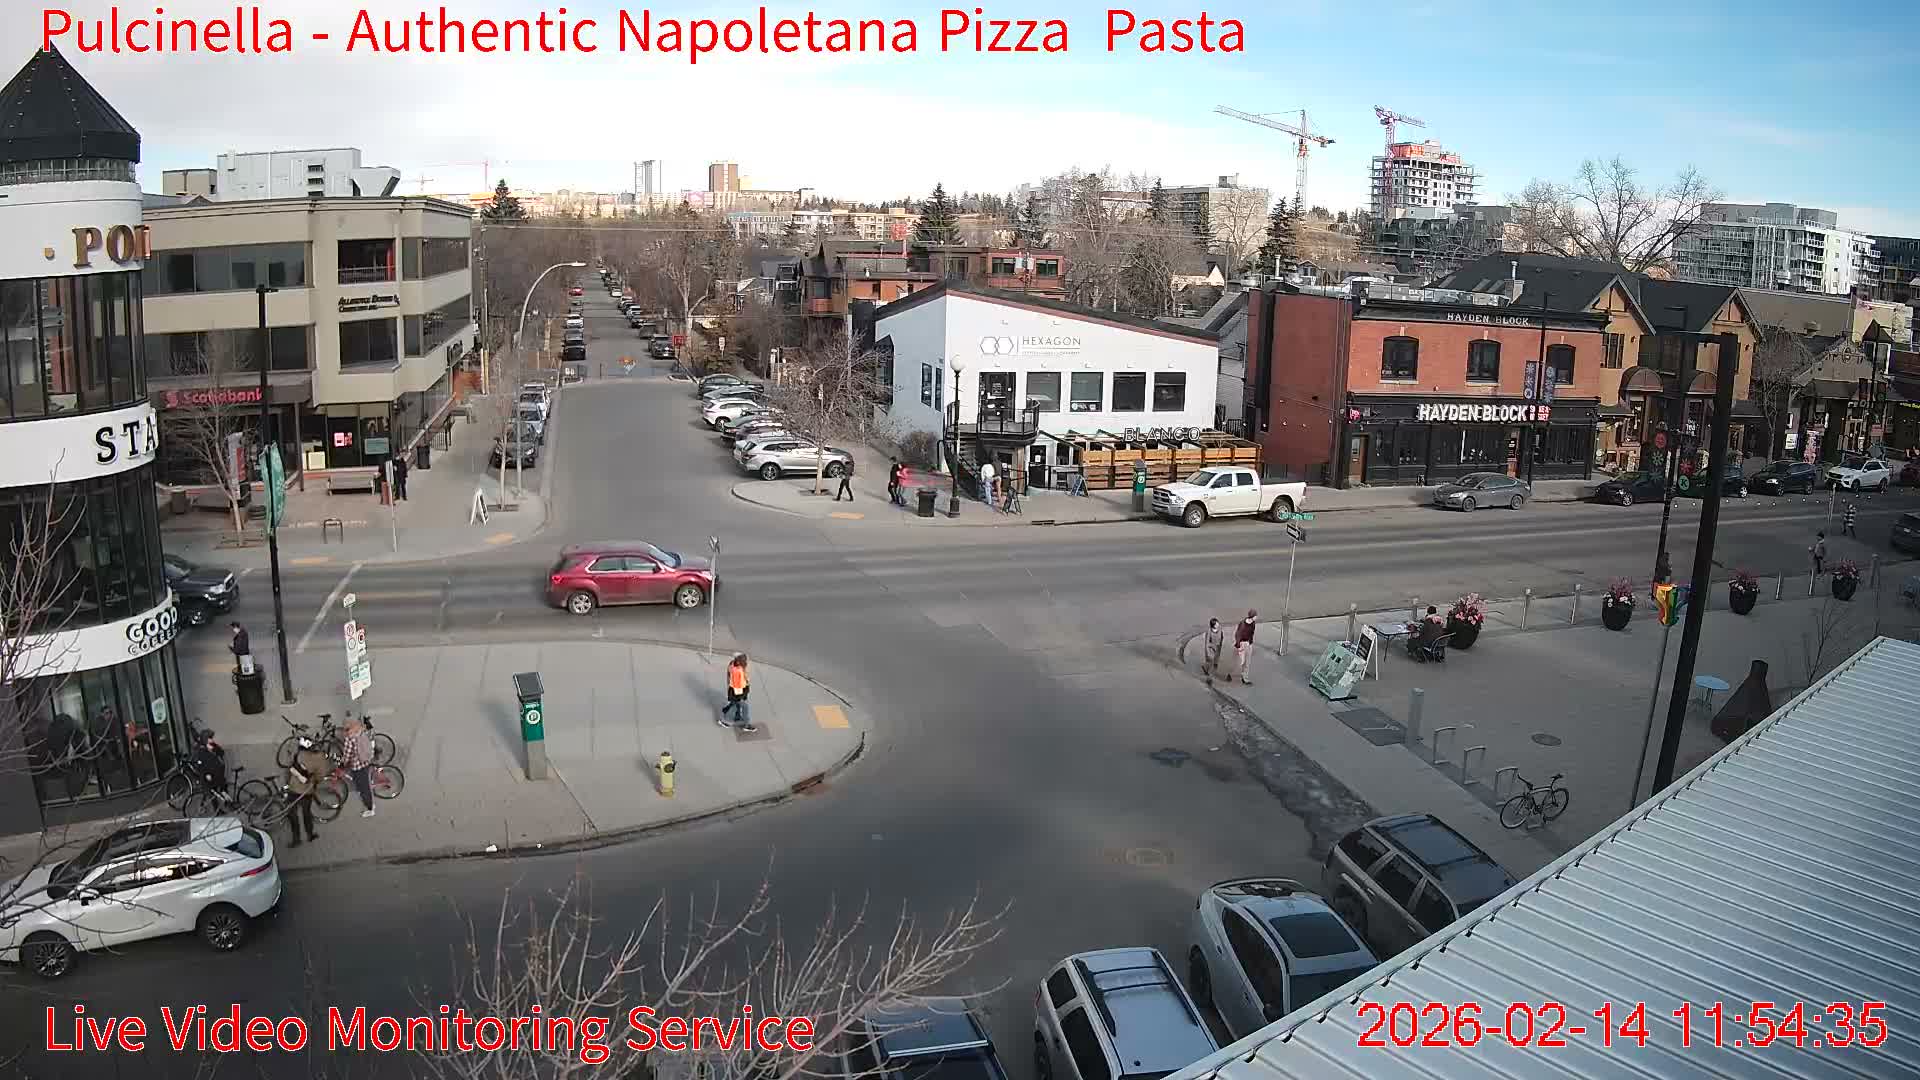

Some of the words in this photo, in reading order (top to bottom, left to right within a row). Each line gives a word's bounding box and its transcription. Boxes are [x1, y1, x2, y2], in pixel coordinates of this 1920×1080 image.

[1447, 312, 1489, 323] HAYDEN
[1496, 316, 1529, 326] BLOCK
[1022, 336, 1081, 346] HEXAGON
[1418, 403, 1479, 421] HAYDEN
[1482, 404, 1528, 421] BLOCK
[1124, 427, 1200, 441] BLANCO
[126, 606, 177, 643] GOOD
